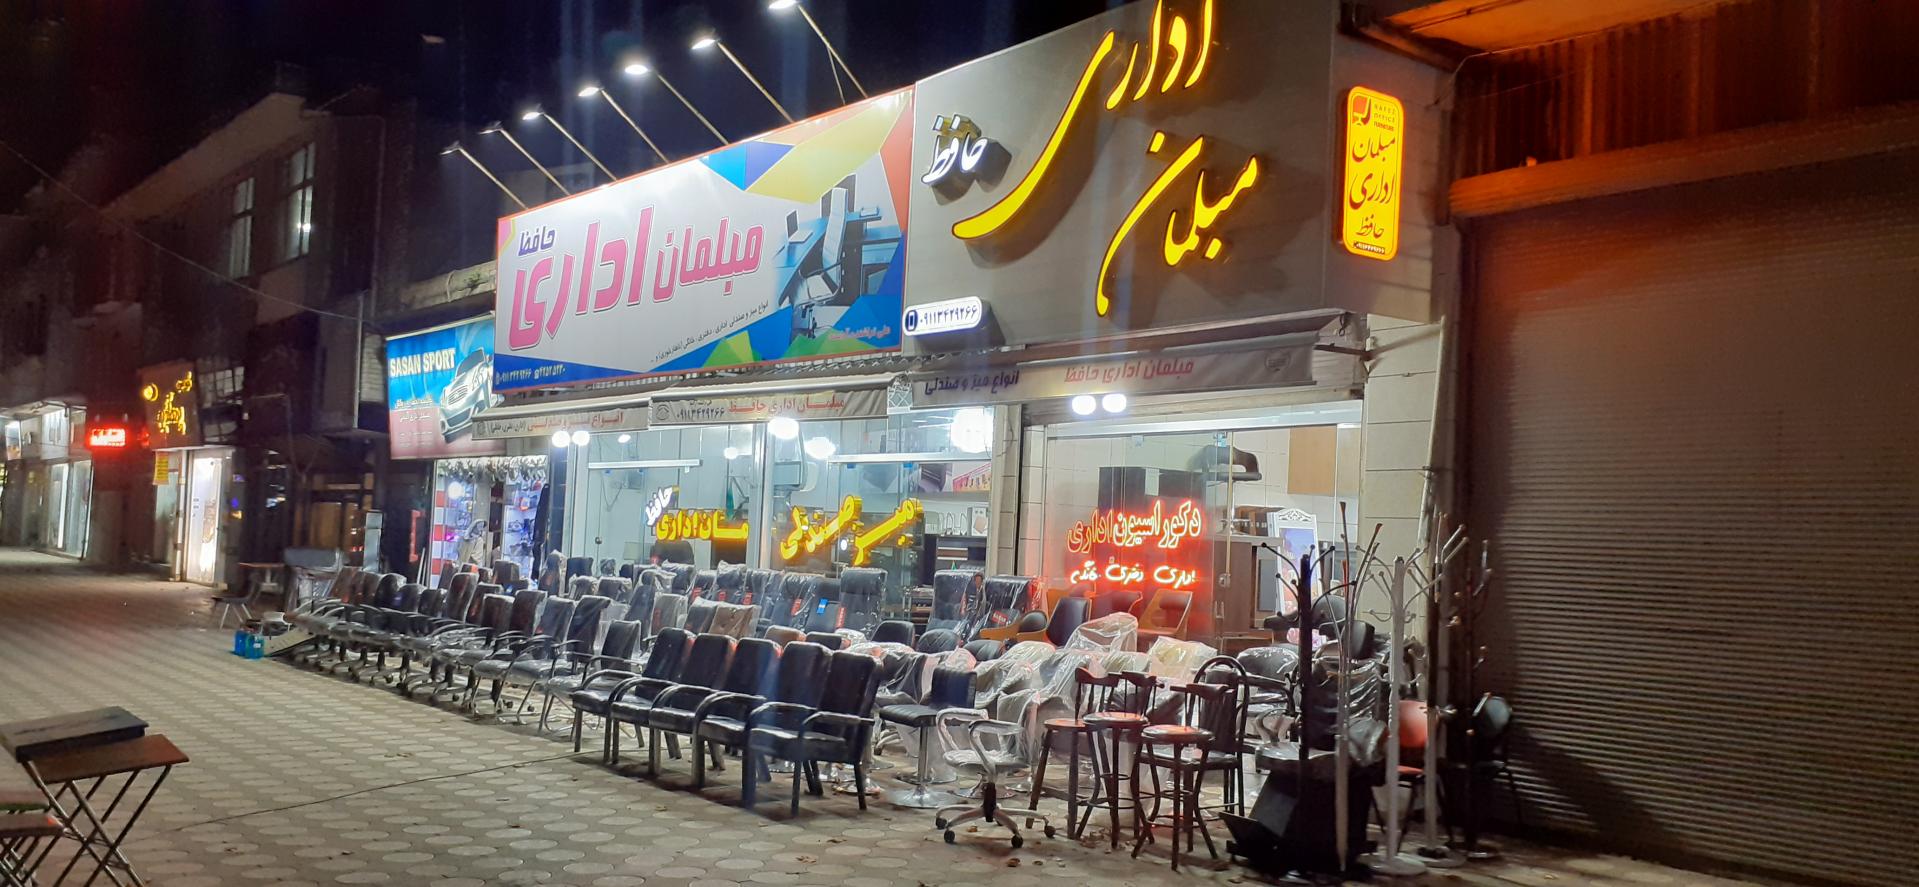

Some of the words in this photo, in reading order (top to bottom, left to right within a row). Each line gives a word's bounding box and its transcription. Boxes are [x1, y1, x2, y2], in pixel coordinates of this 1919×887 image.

[952, 0, 1213, 239] اداری
[921, 114, 989, 184] حافظ
[1352, 133, 1395, 162] مبلمان
[1350, 171, 1395, 210] اداری
[1096, 131, 1258, 317] مبلمان
[1356, 214, 1384, 238] حافظ
[518, 225, 556, 257] حافظ
[652, 216, 765, 303] مبلمان
[508, 205, 655, 351] اداری
[390, 355, 421, 378] SASAN
[423, 347, 456, 373] SPORT
[1064, 364, 1099, 383] حافظ
[1102, 361, 1139, 384] اداری
[1143, 358, 1194, 381] مبلمان
[925, 376, 959, 395] صندلی
[962, 379, 969, 391] و
[971, 374, 989, 391] میز
[991, 370, 1020, 394] انواع
[592, 410, 624, 428] انواع
[728, 399, 768, 414] حافظ
[768, 398, 796, 415] اداری
[797, 394, 845, 413] مبلمان
[645, 485, 673, 526] حافظ
[656, 510, 698, 541] اداری
[779, 495, 861, 560] صندلی
[854, 497, 922, 567] میز
[1067, 508, 1114, 553] اداری
[1113, 499, 1202, 548] دکوراسیون
